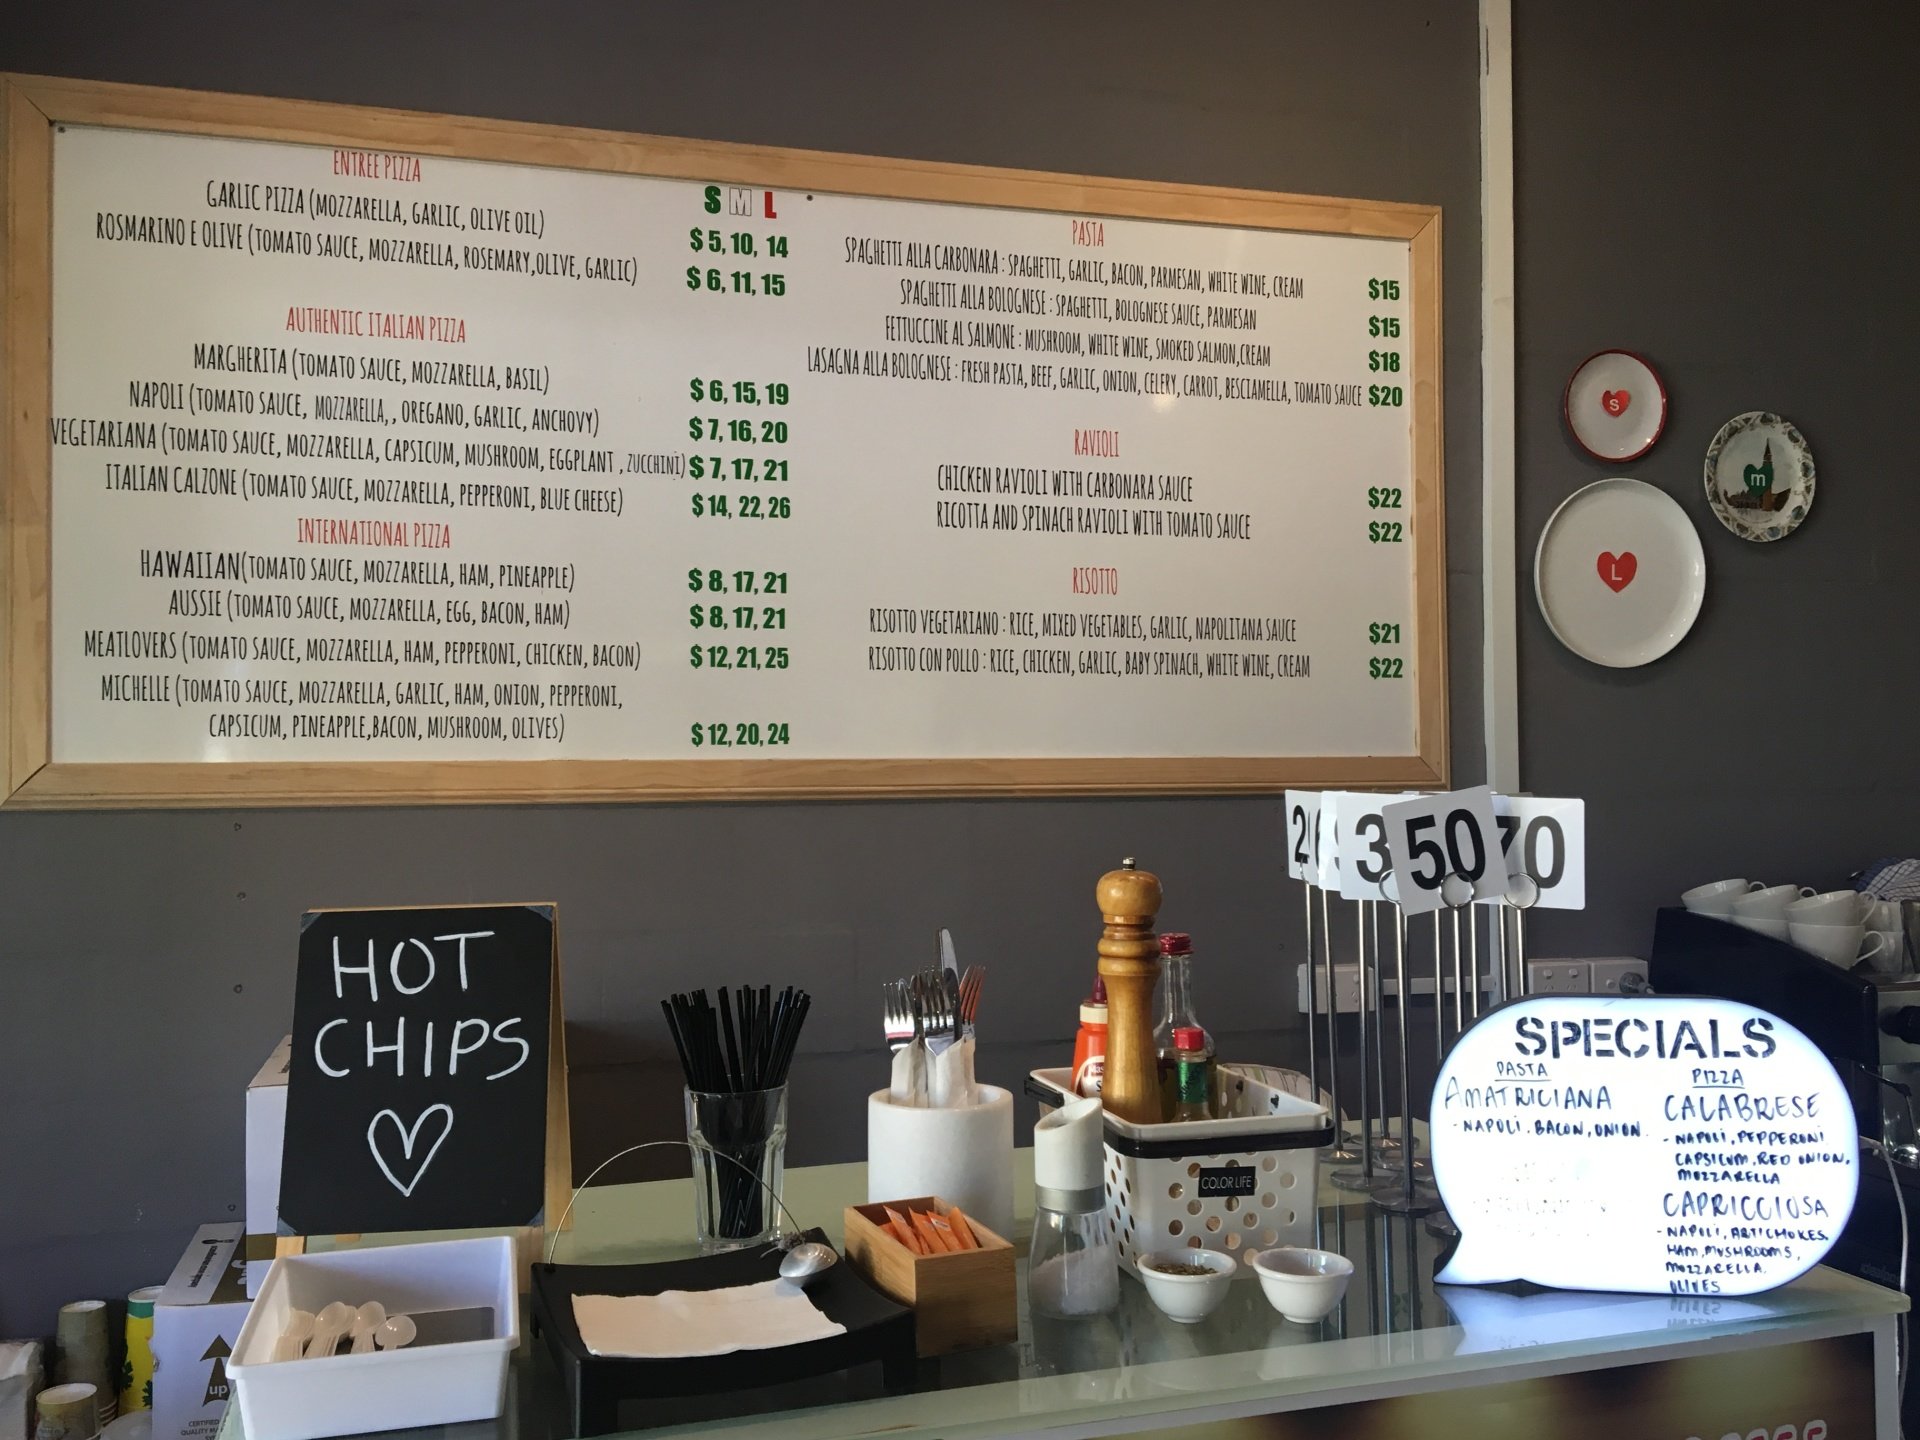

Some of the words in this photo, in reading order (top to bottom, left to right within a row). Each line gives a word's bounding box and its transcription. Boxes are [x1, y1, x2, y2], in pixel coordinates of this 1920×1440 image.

[334, 150, 379, 178] ENTREE
[385, 158, 420, 182] PIZZA
[207, 180, 260, 210] GARLIC
[266, 186, 304, 214] PIZZA
[310, 188, 407, 226] (MOZZARELLA,
[412, 202, 465, 231] GARLIC,
[471, 208, 510, 232] OLIVE
[515, 210, 544, 239] OIL)
[704, 186, 721, 214] S
[729, 188, 752, 216] M
[765, 192, 777, 219] L
[97, 212, 185, 245] ROSMARINO
[191, 220, 197, 246] E
[203, 221, 243, 249] OLIVE
[248, 224, 311, 256] (TOMATO
[317, 233, 363, 262] SAUCE,
[369, 238, 458, 270] MOZZARELLA,
[586, 257, 637, 286] GARLIC)
[1073, 221, 1103, 247] PASTA
[845, 237, 902, 266] SPAGHETTI
[906, 242, 930, 269] ALLA
[935, 245, 998, 274] CARBONARA
[1009, 254, 1065, 283] SPAGHETTI,
[1069, 259, 1108, 286] GARLIC,
[1112, 262, 1147, 289] BACON,
[1151, 266, 1204, 293] PARMESAN,
[1208, 271, 1237, 294] WHITE
[1241, 274, 1270, 299] WINE,
[1274, 276, 1303, 299] CREAM
[901, 279, 956, 308] SPAGHETTI
[960, 284, 984, 310] ALLA
[989, 286, 1046, 315] BOLOGNESE
[1056, 294, 1112, 322] SPAGHETTI,
[1116, 299, 1168, 324] BOLOGNESE
[1172, 303, 1204, 329] SAUCE,
[1208, 306, 1256, 330] PARMESAN
[1369, 278, 1399, 301] $15
[286, 307, 363, 336] AUTHENTIC
[369, 312, 424, 340] ITALIAN
[430, 317, 465, 343] PIZZA
[1369, 315, 1400, 338] $15
[195, 343, 286, 374] MARGHERITA
[292, 348, 354, 380] (TOMATO
[360, 357, 406, 385] SAUCE,
[412, 361, 500, 391] MOZZARELLA,
[506, 366, 549, 395] BASIL)
[1369, 350, 1400, 373] $18
[1369, 384, 1402, 407] $20
[1609, 399, 1619, 411] S
[1075, 429, 1119, 457] RAVIOLI
[106, 464, 167, 492] ITALIAN
[174, 467, 237, 495] CALZONE
[243, 469, 306, 501] (TOMATO
[312, 476, 358, 503] SAUCE,
[364, 479, 454, 508] MOZZARELLA,
[460, 484, 535, 511] PEPPERONI,
[541, 487, 570, 510] BLUE
[575, 488, 622, 517] CHEESE)
[938, 464, 991, 493] CHICKEN
[996, 467, 1048, 495] RAVIOLI
[1052, 470, 1082, 496] WITH
[1087, 472, 1154, 500] CARBONARA
[1159, 475, 1192, 502] SAUCE
[1368, 486, 1401, 509] $22
[298, 518, 409, 547] INTERNATIONAL
[414, 523, 450, 548] PIZZA
[937, 501, 988, 529] RICOTTA
[993, 504, 1017, 530] AND
[1022, 505, 1073, 532] SPINACH
[1078, 507, 1128, 535] RAVIOLI
[1133, 510, 1162, 536] WITH
[1167, 511, 1212, 538] TOMATO
[1217, 513, 1250, 539] SAUCE
[1369, 521, 1402, 543] $22
[1073, 567, 1117, 595] RISOTTO
[1611, 564, 1623, 581] L
[169, 590, 221, 616] AUSSIE
[227, 590, 291, 622] (TOMATO
[297, 596, 344, 622] SAUCE,
[350, 598, 441, 625] MOZZARELLA,
[447, 600, 476, 626] EGG,
[482, 601, 529, 627] BACON,
[535, 600, 569, 629] HAM)
[870, 608, 916, 633] RISOTTO
[921, 610, 998, 635] VEGETARIANO
[1010, 612, 1038, 639] RICE,
[1043, 613, 1076, 637] MIXED
[1080, 614, 1146, 641] VEGETABLES,
[1151, 616, 1192, 642] GARLIC,
[1196, 617, 1262, 640] NAPOLITANA
[1266, 618, 1296, 642] SAUCE
[1369, 622, 1400, 645] $21
[85, 630, 176, 659] MEATLOVERS
[183, 631, 247, 664] (TOMATO
[253, 637, 300, 663] SAUCE,
[307, 639, 398, 665] MOZZARELLA,
[405, 640, 439, 666] HAM,
[445, 642, 520, 667] PEPPERONI,
[526, 643, 587, 668] CHICKEN,
[593, 642, 640, 671] BACON)
[869, 646, 915, 671] RISOTTO
[920, 648, 942, 671] CON
[947, 648, 978, 672] POLLO
[990, 649, 1019, 676] RICE,
[1023, 649, 1075, 676] CHICKEN,
[1079, 651, 1121, 677] GARLIC,
[1126, 651, 1150, 675] BABY
[1154, 652, 1202, 678] SPINACH,
[1207, 653, 1238, 676] WHITE
[1242, 654, 1274, 679] WINE,
[1278, 655, 1310, 677] CREAM
[1369, 657, 1403, 680] $22
[210, 714, 287, 740] CAPSICUM,
[428, 716, 507, 741] MUSHROOM,
[513, 714, 564, 743] OLIVES)
[1405, 808, 1486, 890] 50
[333, 930, 495, 1002] HOT
[315, 1016, 530, 1081] CHIPS
[1515, 1016, 1776, 1059] SPECIALS
[1497, 1061, 1548, 1077] PASTA
[1692, 1068, 1744, 1085] PIZZA
[1664, 1092, 1821, 1122] CALABRESE
[1757, 1151, 1791, 1165] RED
[1201, 1176, 1234, 1190] COLOR
[1235, 1175, 1252, 1189] LIFE
[1677, 1168, 1780, 1185] MOZZARELLA
[1663, 1191, 1829, 1221] CAPRICCIOSA
[1669, 1279, 1721, 1294] OLIVES
[209, 1385, 228, 1398] up
